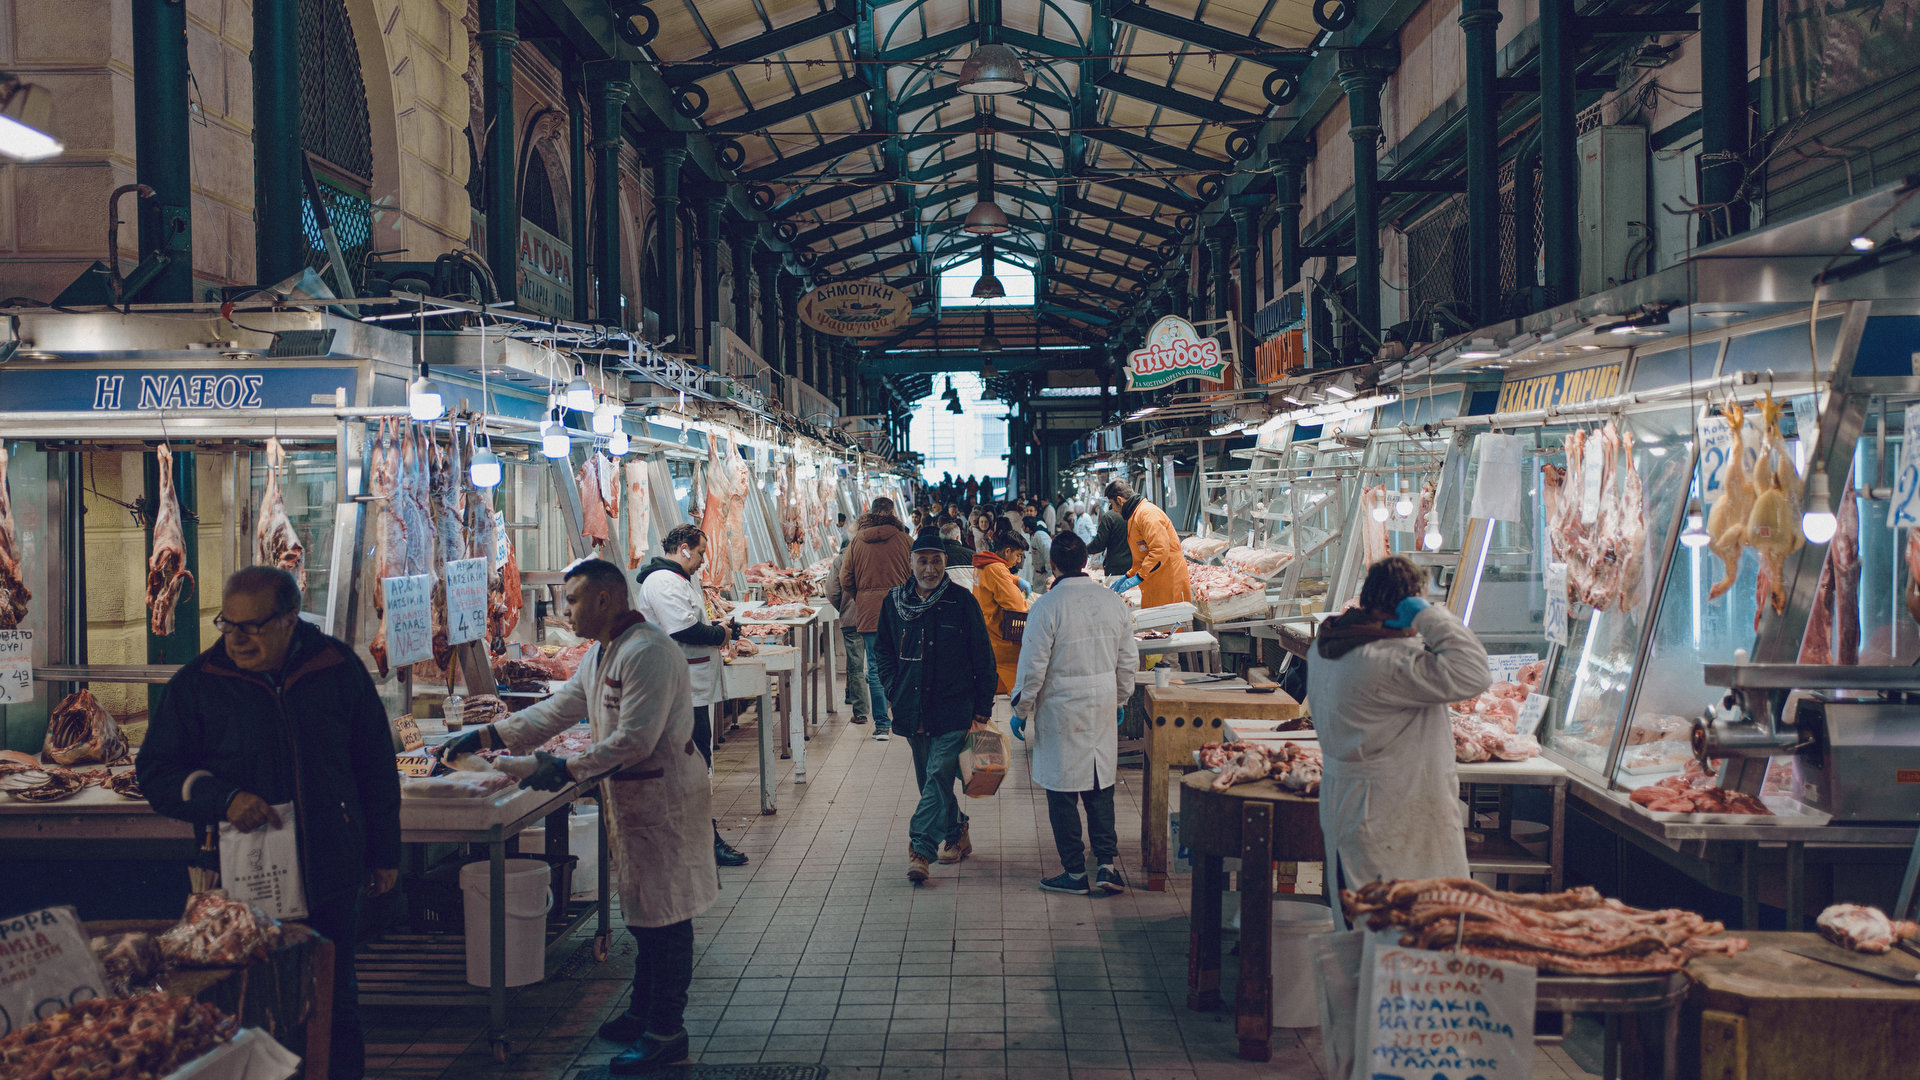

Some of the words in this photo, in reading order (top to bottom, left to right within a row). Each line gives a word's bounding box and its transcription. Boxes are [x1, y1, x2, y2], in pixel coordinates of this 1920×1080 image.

[520, 231, 572, 287] ΑΓΟΡΑ
[817, 284, 894, 302] ΔΗΜΟΤΙΚΗ
[93, 376, 124, 409] Η
[137, 375, 263, 409] ΝΑΞΟΣ
[1500, 375, 1557, 413] ΕΚΛΕΚΤΑ
[395, 617, 426, 632] ΕΛΛΑΣ
[0, 631, 33, 641] ΒΑΤΟ
[0, 643, 23, 652] ΟΥΡΙ
[1380, 950, 1505, 984] ΠΡΟΣΦΟΡΑ
[1378, 996, 1491, 1018] ΑΡΝΑΚΙΑ
